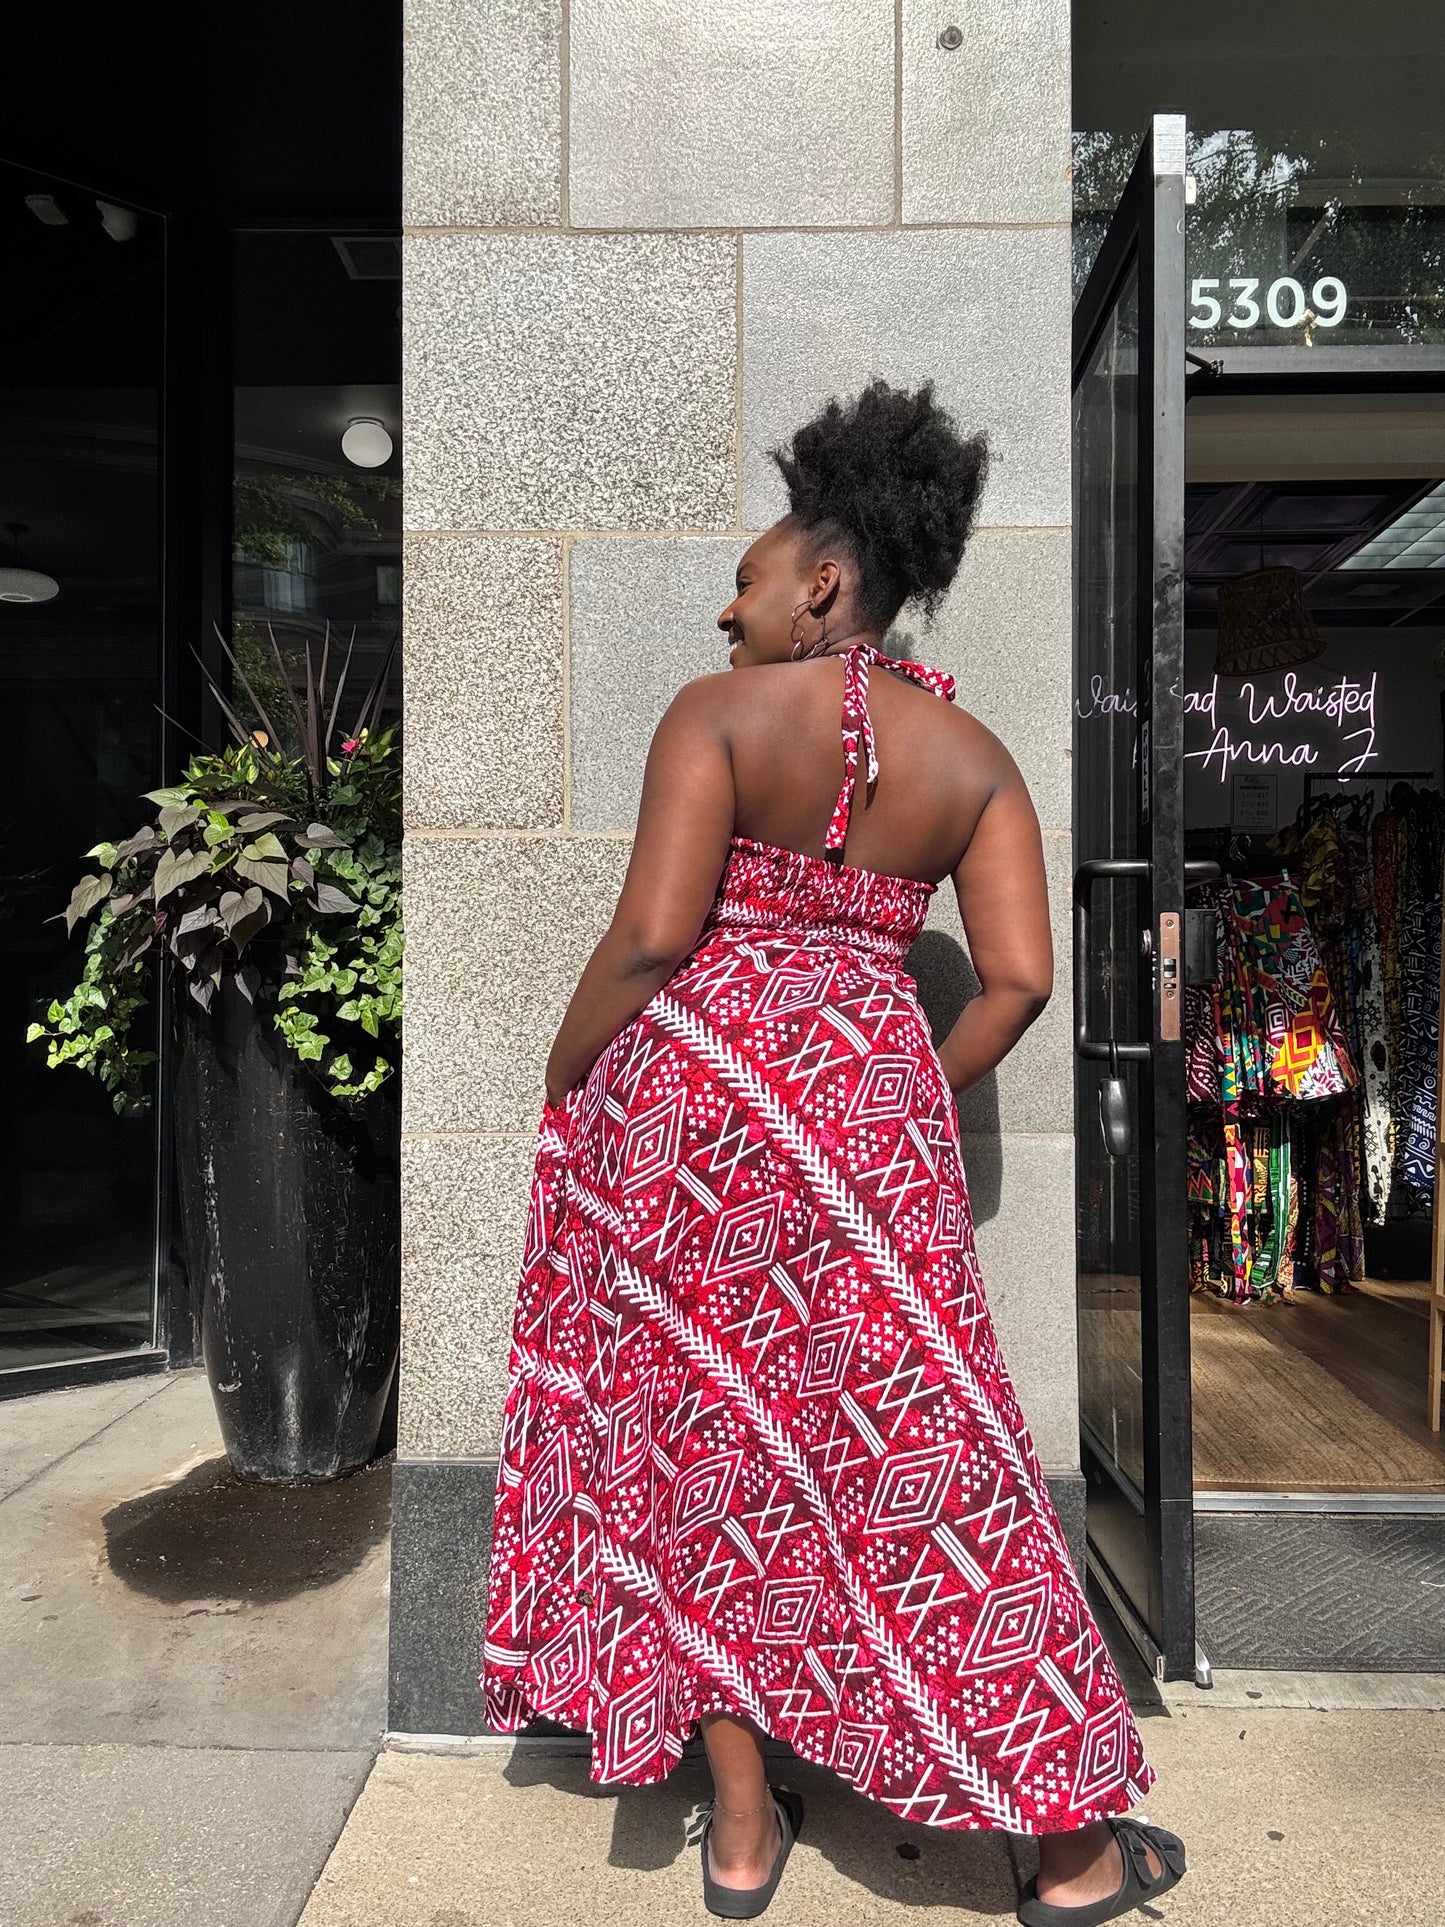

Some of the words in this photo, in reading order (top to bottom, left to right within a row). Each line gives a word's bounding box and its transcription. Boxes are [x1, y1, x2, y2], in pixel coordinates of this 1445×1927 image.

[1188, 276, 1347, 329] 5309
[1240, 672, 1377, 728] Waisted
[1182, 727, 1319, 783] Anna
